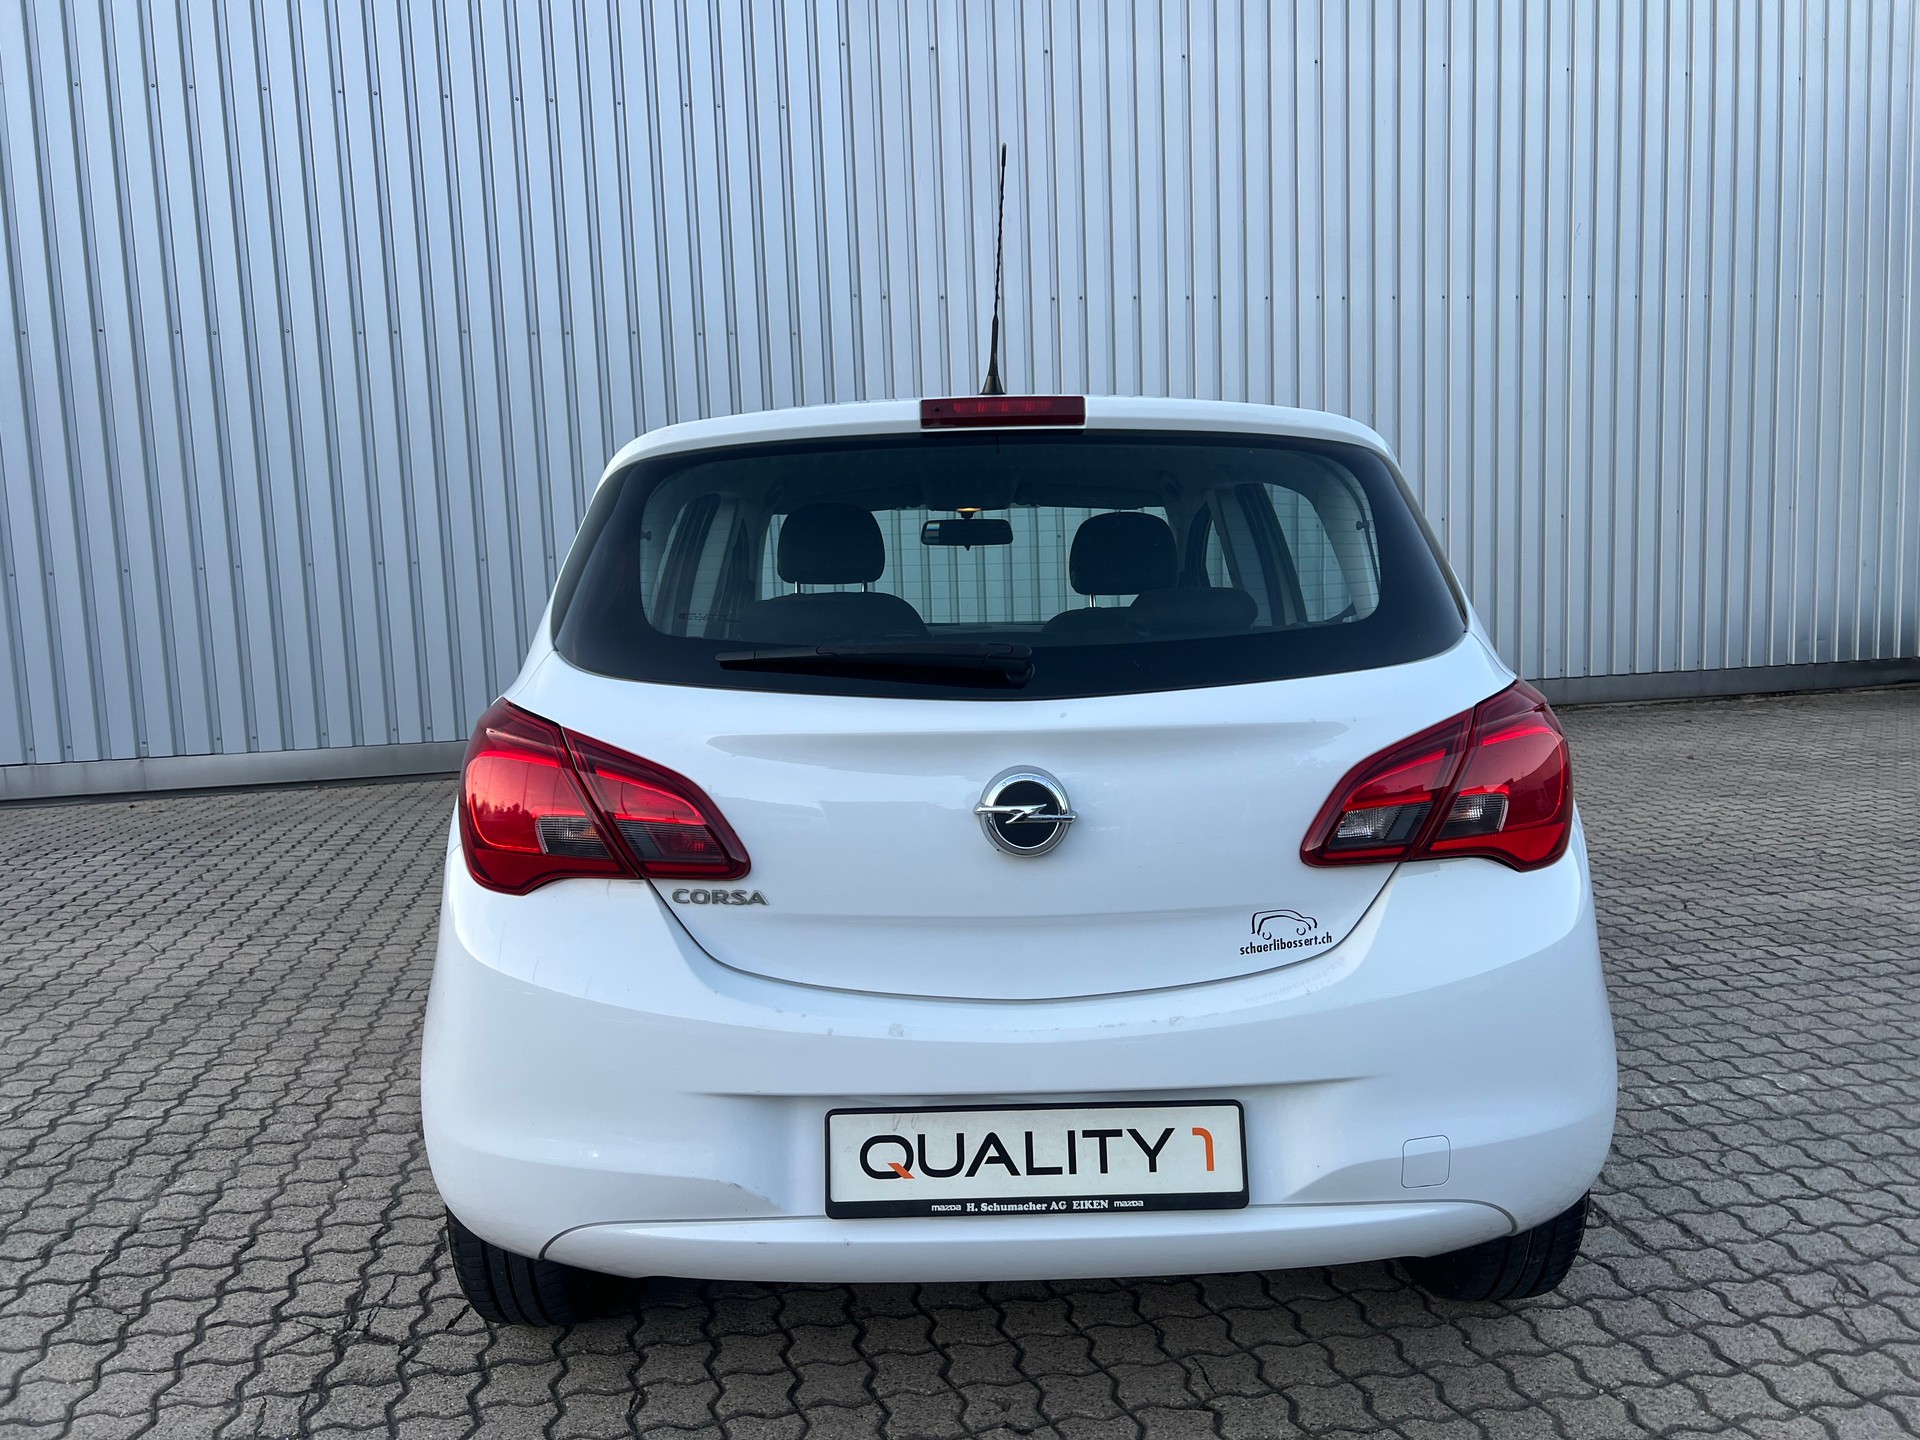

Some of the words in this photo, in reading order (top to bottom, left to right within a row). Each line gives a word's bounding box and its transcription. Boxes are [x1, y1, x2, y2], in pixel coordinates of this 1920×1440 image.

[672, 888, 769, 905] CORSA
[1240, 931, 1332, 955] schaerlibossert.ch
[859, 1127, 1176, 1180] QUALITY
[1191, 1126, 1215, 1172] 1
[966, 1203, 978, 1212] H.
[980, 1202, 1048, 1212] Schumacher
[1050, 1201, 1067, 1210] AG
[1072, 1200, 1109, 1210] EIKEN
